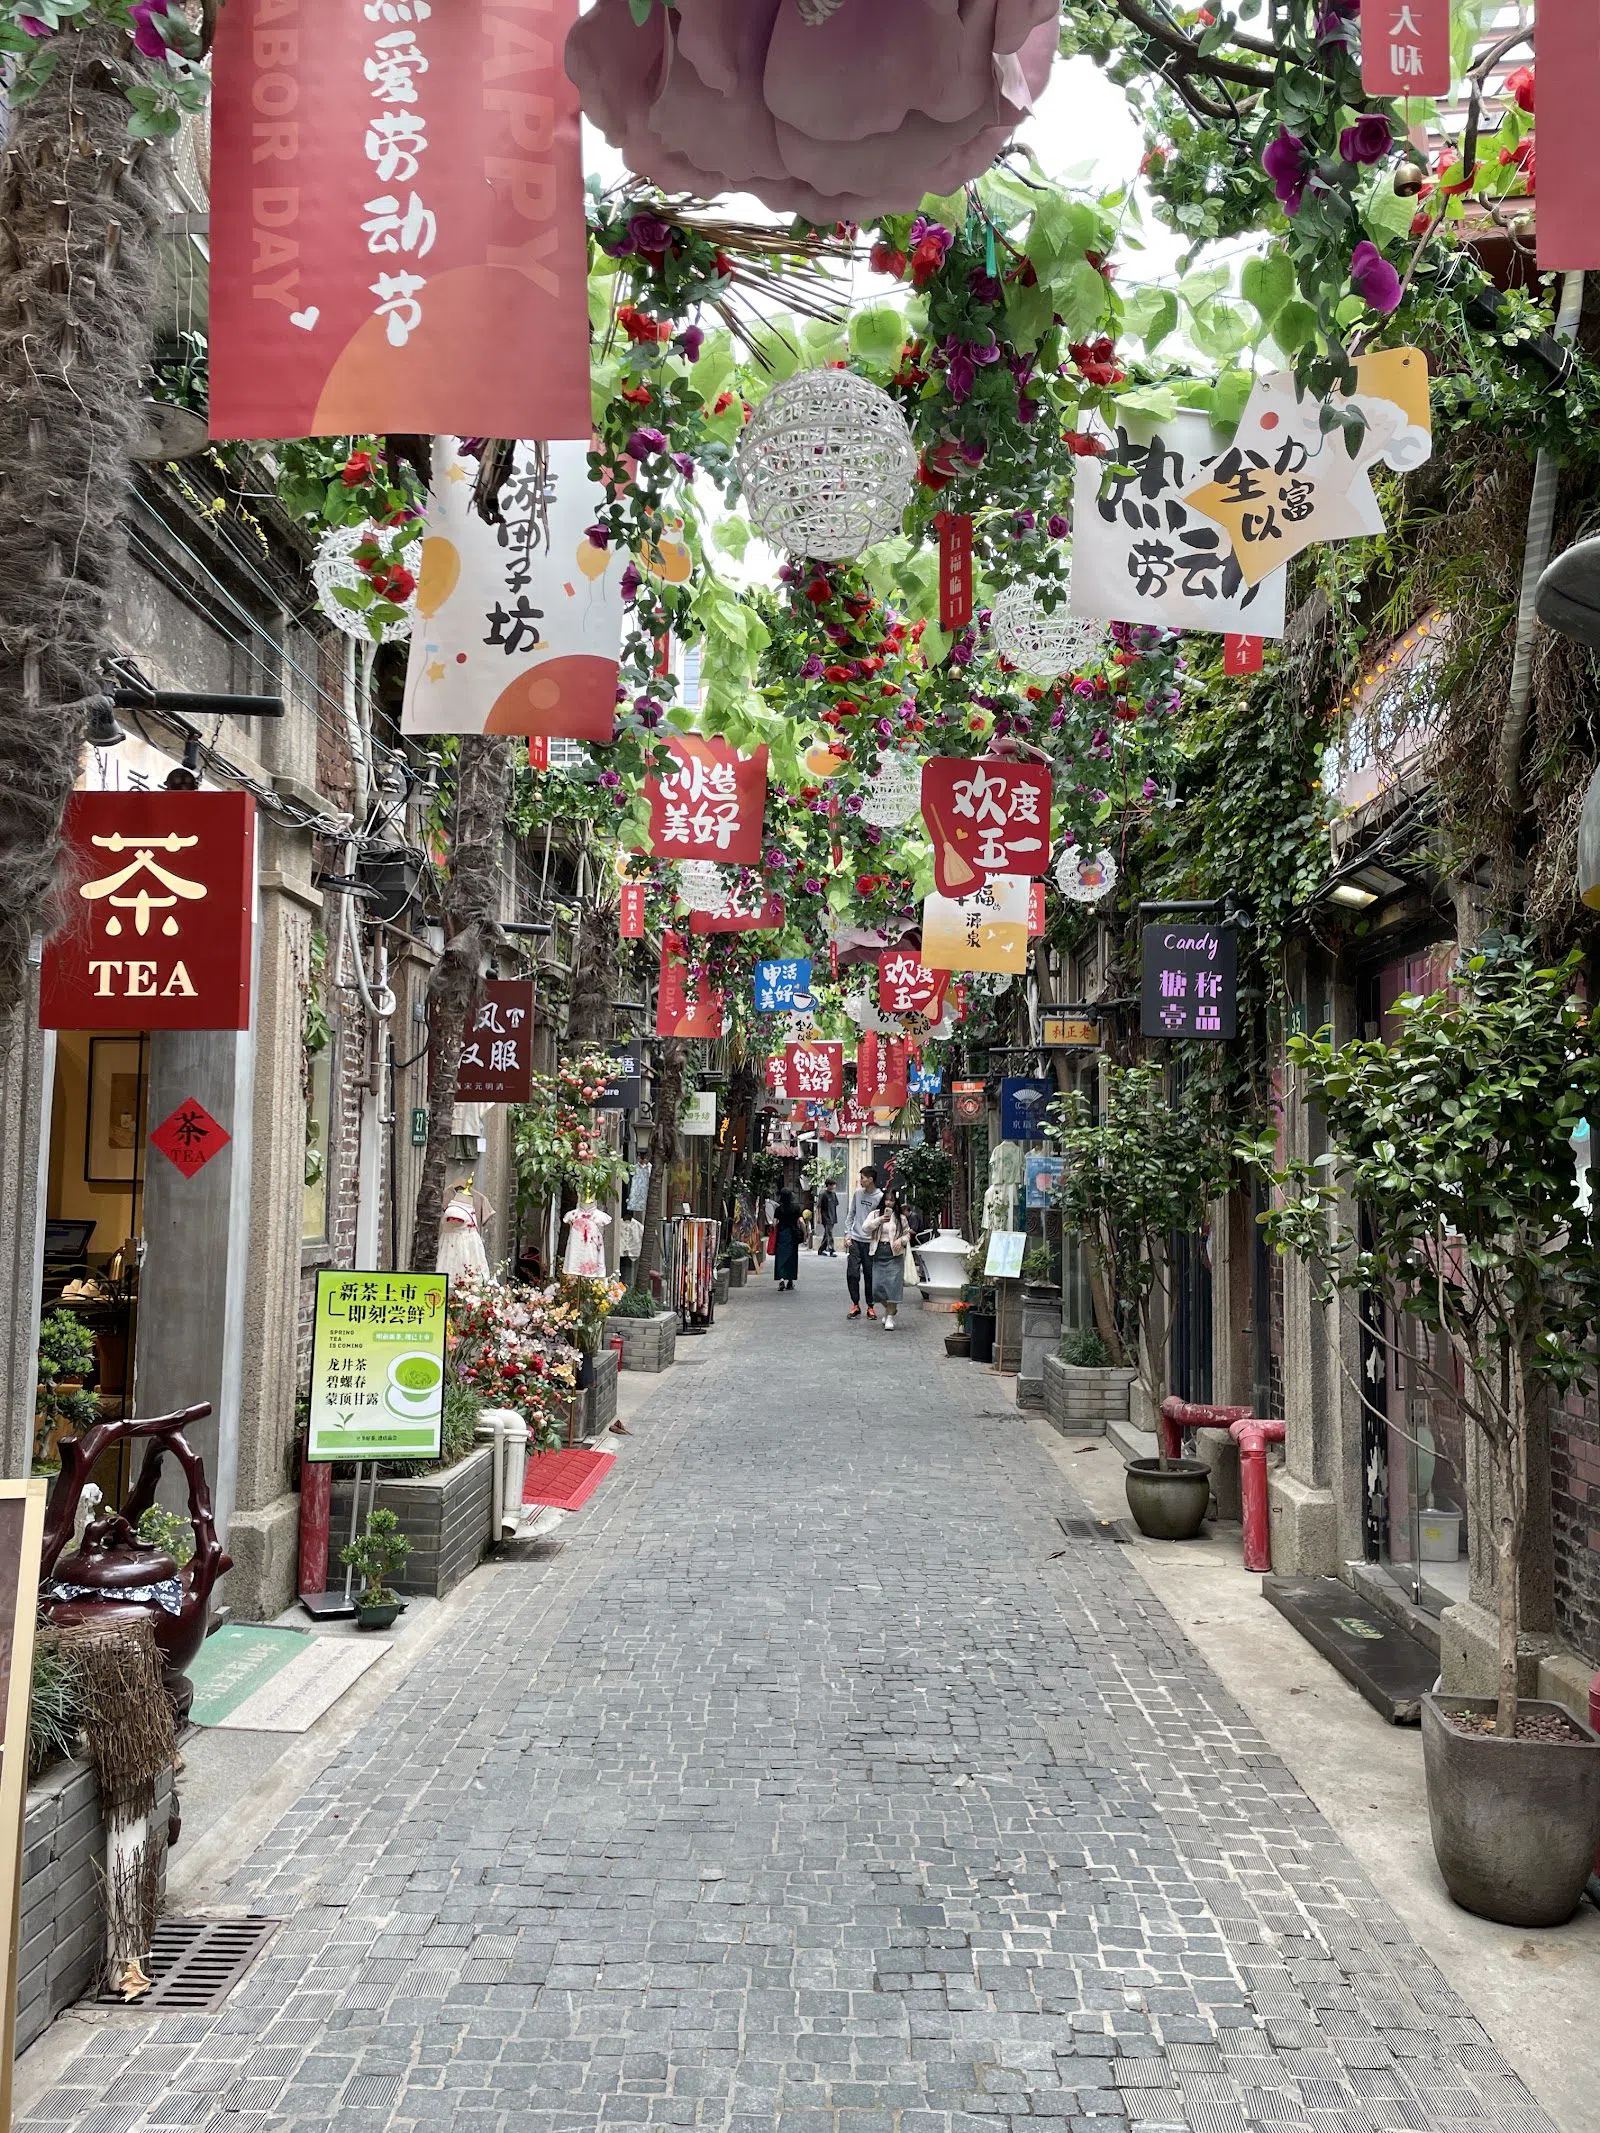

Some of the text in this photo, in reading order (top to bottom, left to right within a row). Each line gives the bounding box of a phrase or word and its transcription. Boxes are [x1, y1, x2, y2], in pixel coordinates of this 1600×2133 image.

[482, 0, 561, 300] APPY
[251, 187, 303, 313] DAY
[1242, 479, 1315, 542] 以富
[659, 755, 738, 802] 创造
[952, 765, 1041, 826] 欢度
[660, 801, 740, 849] 美好
[973, 828, 1042, 868] 五一
[80, 832, 207, 936] 茶
[966, 912, 982, 948] 源泉
[1164, 932, 1218, 960] Candy
[89, 960, 198, 997] TEA
[763, 963, 797, 987] 申活
[760, 984, 793, 1009] 美好
[892, 987, 931, 1009] 五一
[1291, 1011, 1301, 1034] 35
[793, 1050, 831, 1073] 创造
[799, 1072, 832, 1092] 美好
[172, 1111, 210, 1146] 茶
[415, 1113, 423, 1132] 27
[170, 1149, 207, 1162] TEA
[340, 1282, 418, 1303] 新茶上市
[348, 1304, 425, 1324] 即刻尝鲜
[327, 1358, 367, 1371] 龙井茶
[326, 1375, 366, 1389] 碧螺春
[325, 1393, 379, 1406] 蒙顶甘露
